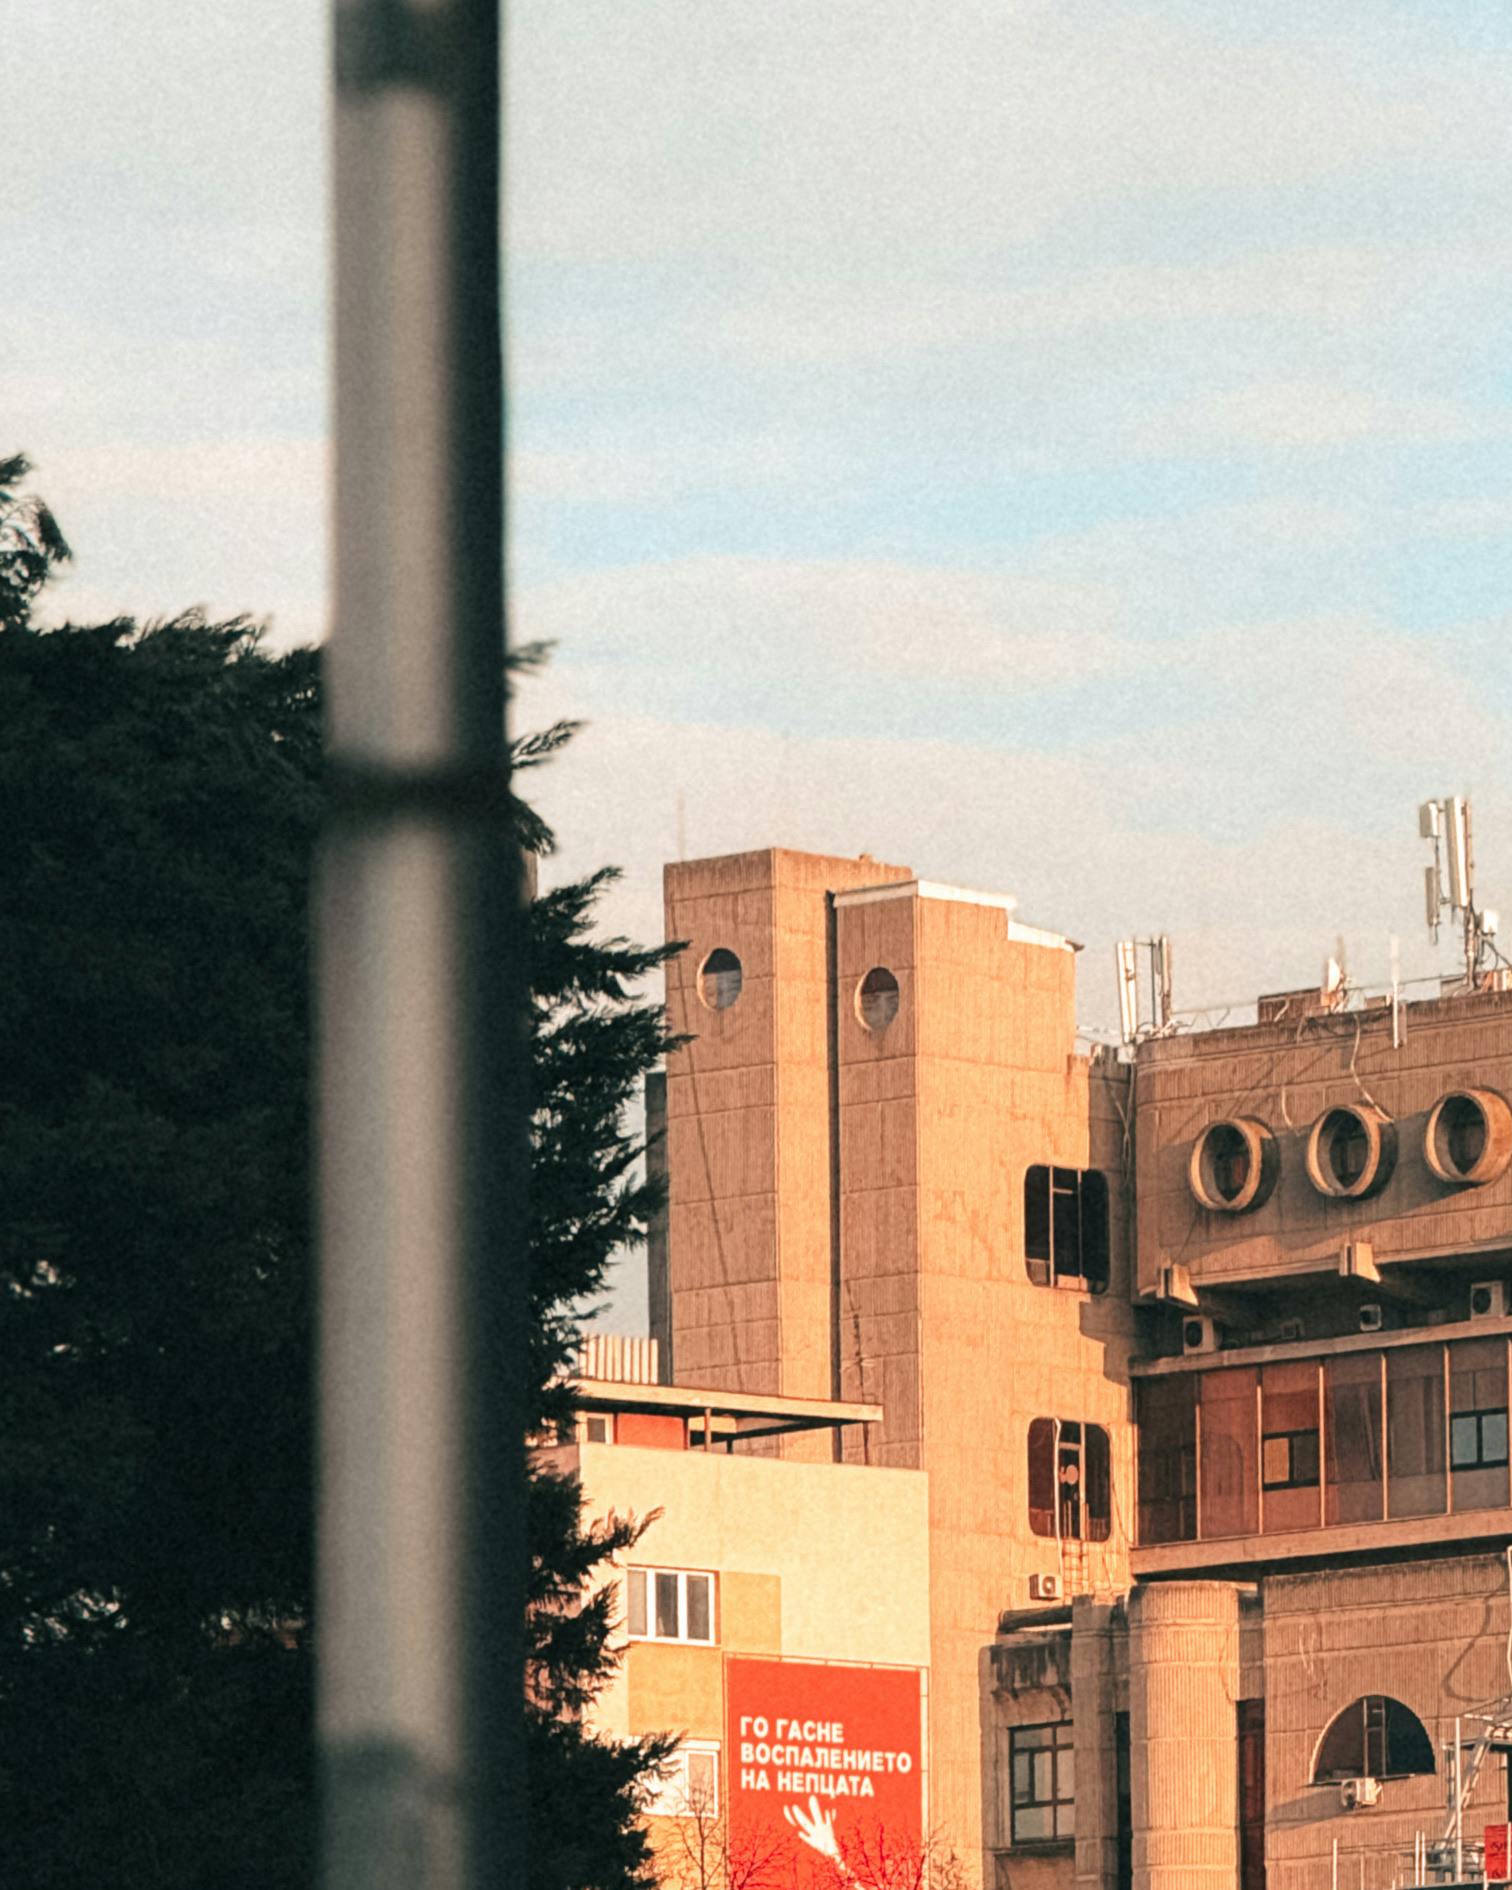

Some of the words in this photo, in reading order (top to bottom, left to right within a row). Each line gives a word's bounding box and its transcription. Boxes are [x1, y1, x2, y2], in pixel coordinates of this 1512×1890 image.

[740, 1715, 769, 1738] ГО
[775, 1718, 844, 1743] ГАСНЕ
[740, 1742, 913, 1773] ВОСПАЛЕНИЕТО
[740, 1768, 770, 1791] НА
[776, 1770, 875, 1799] НЕПЦАТА
